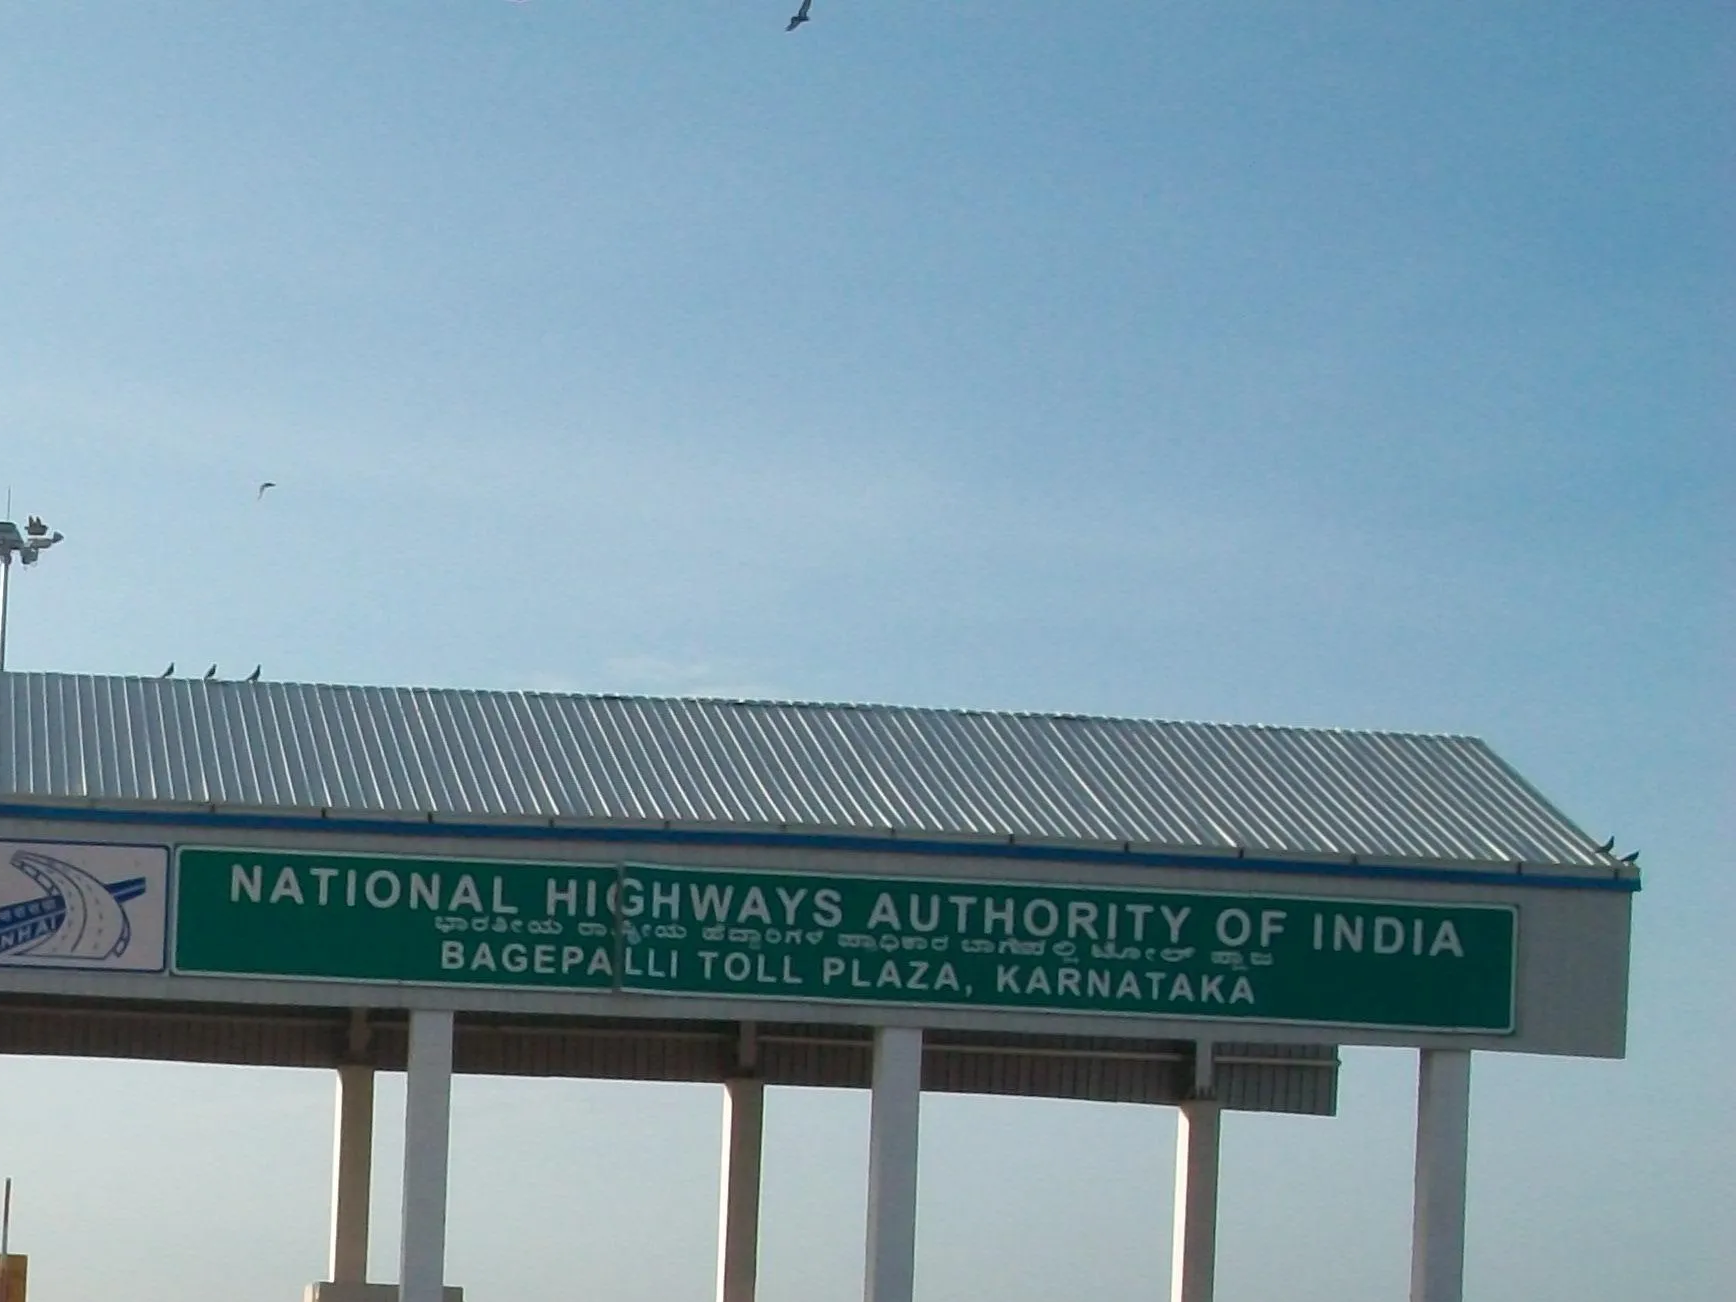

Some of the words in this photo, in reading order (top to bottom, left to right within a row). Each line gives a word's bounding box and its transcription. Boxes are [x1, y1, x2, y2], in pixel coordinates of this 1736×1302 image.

[0, 916, 56, 949] NHAI
[230, 864, 518, 914] NATIONAL
[547, 878, 844, 929] HIGHWAYS
[867, 892, 1193, 945] AUTHORITY
[1215, 907, 1287, 950] OF
[1313, 912, 1464, 958] INDIA
[440, 940, 678, 979] BAGEPALLI
[697, 951, 802, 984] TOLL
[823, 957, 974, 998] PLAZA,
[996, 965, 1255, 1004] KARNATAKA
